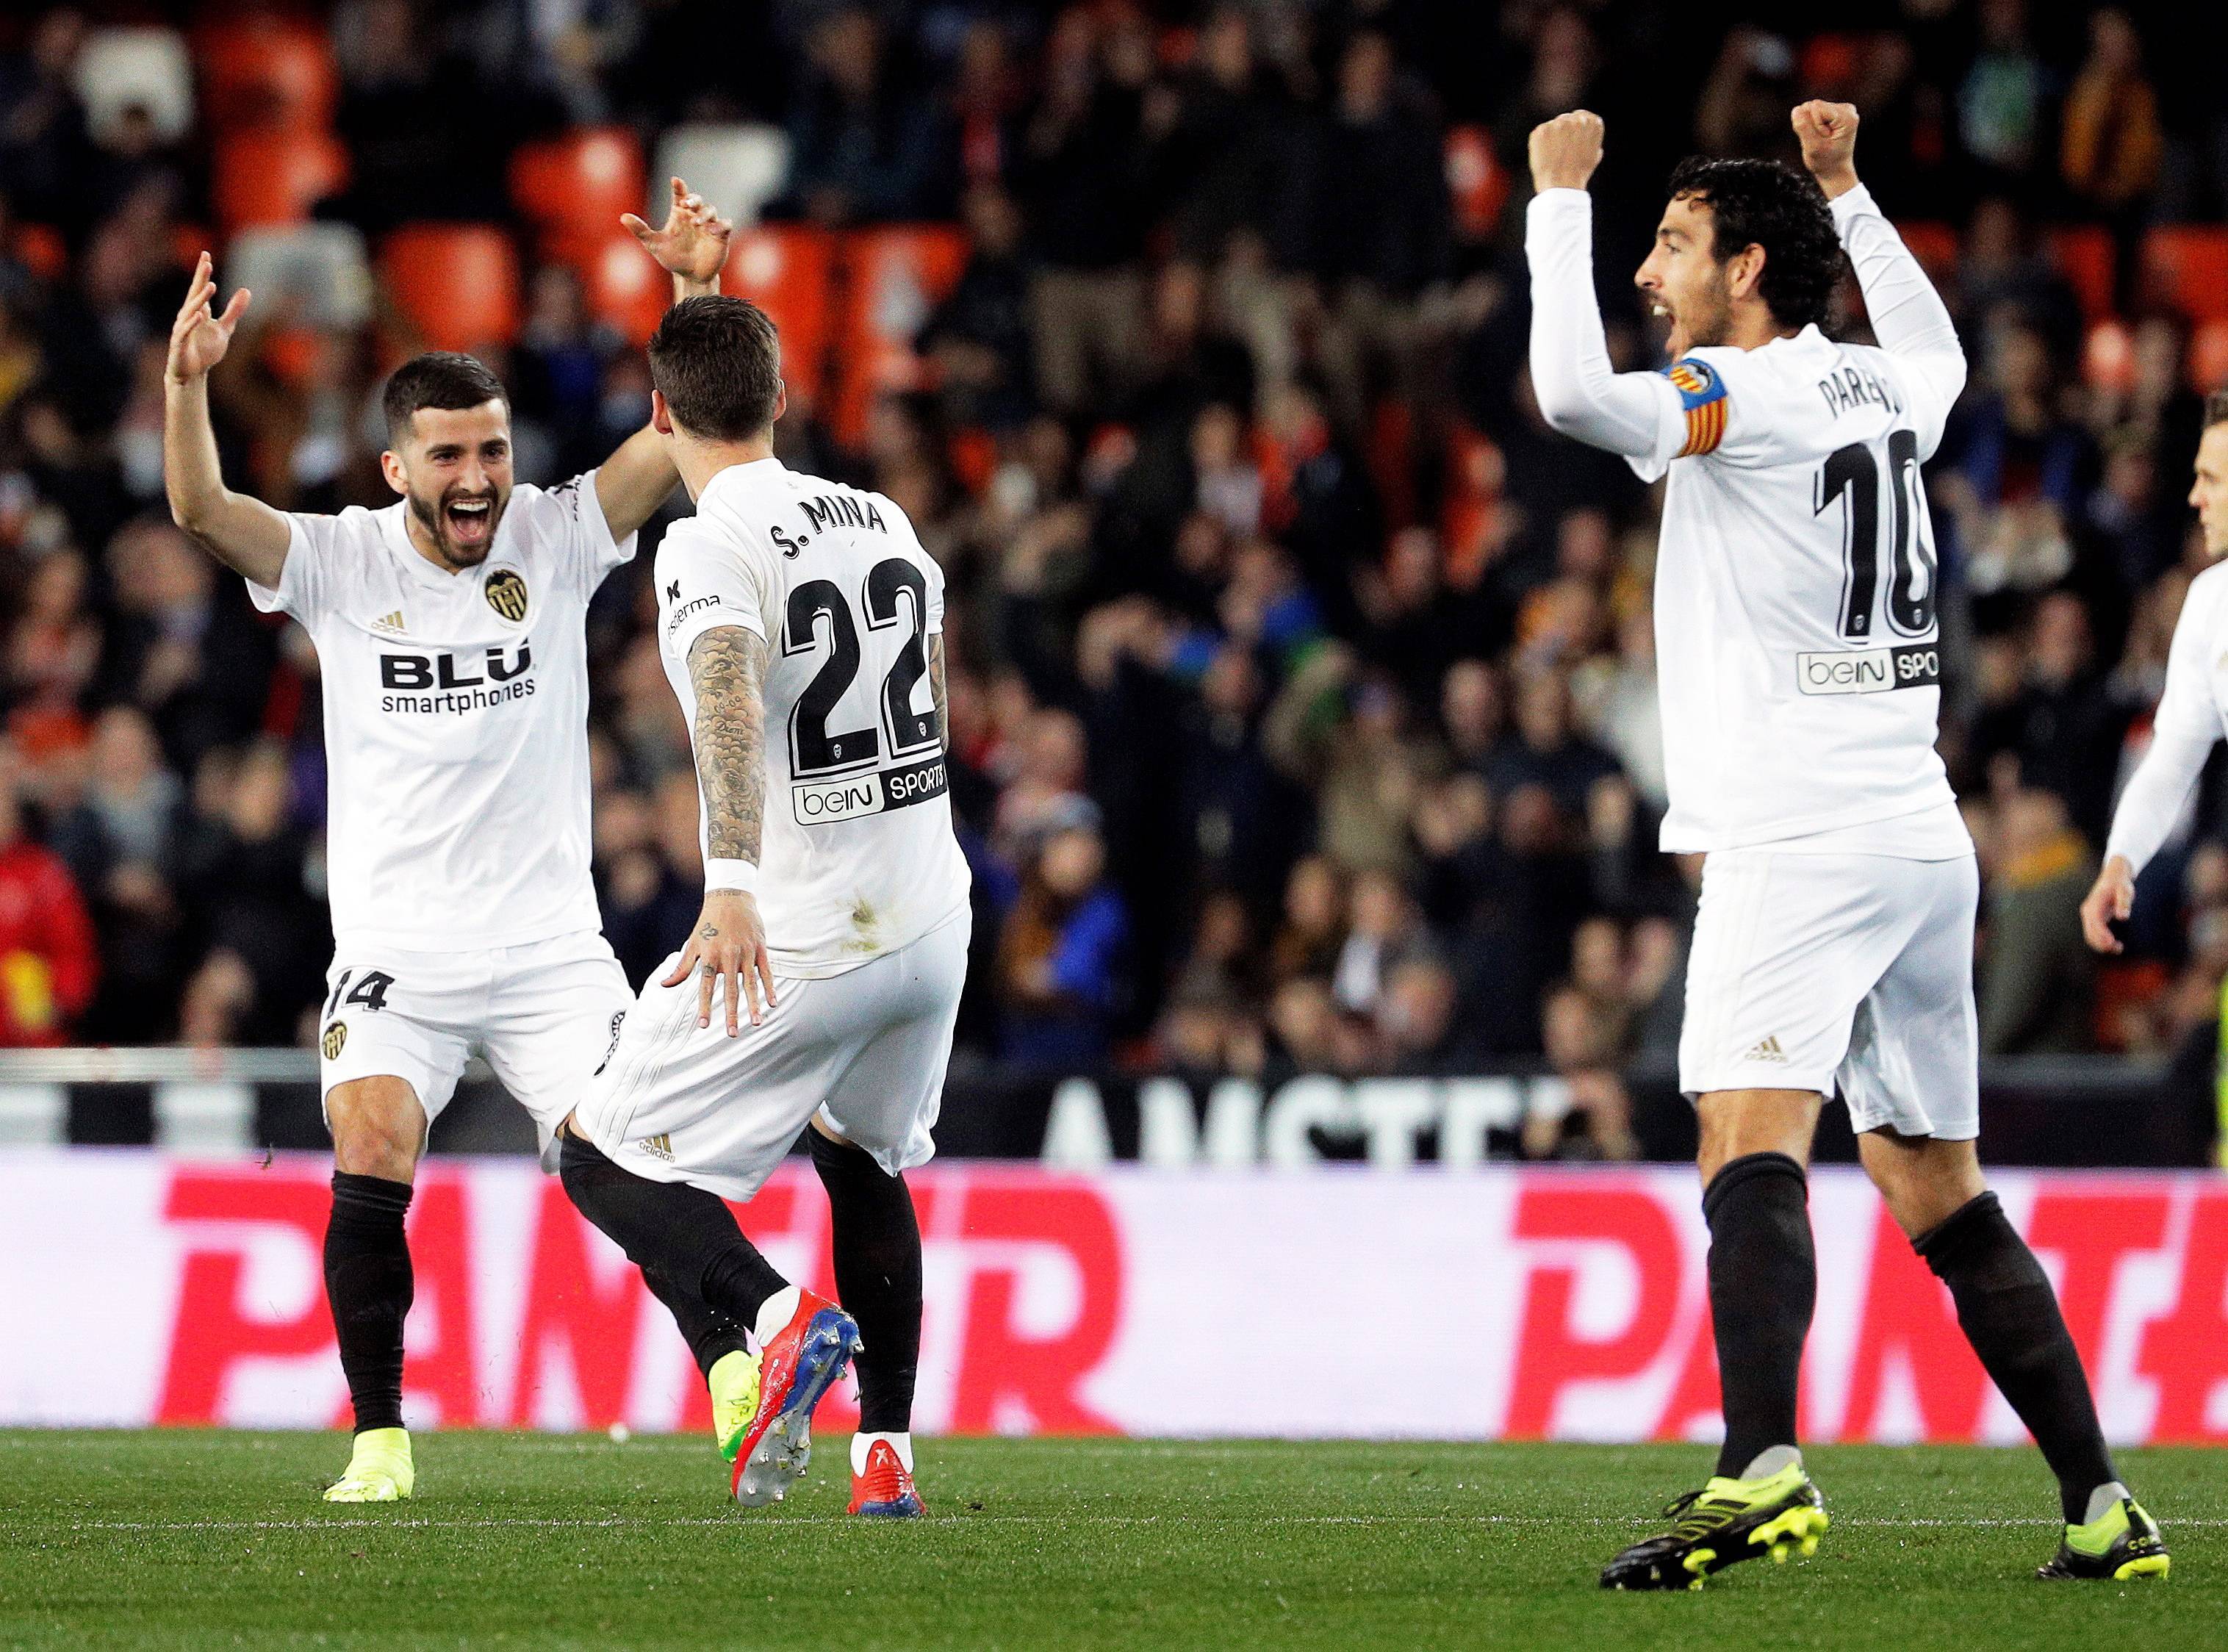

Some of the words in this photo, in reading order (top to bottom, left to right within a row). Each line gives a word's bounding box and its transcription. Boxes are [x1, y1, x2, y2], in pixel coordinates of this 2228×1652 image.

[771, 525, 809, 560] S.
[798, 495, 888, 535] MINA
[781, 557, 943, 780] 22
[381, 678, 536, 715] smartphones
[889, 764, 946, 802] SPORTS
[328, 969, 395, 1019] 14
